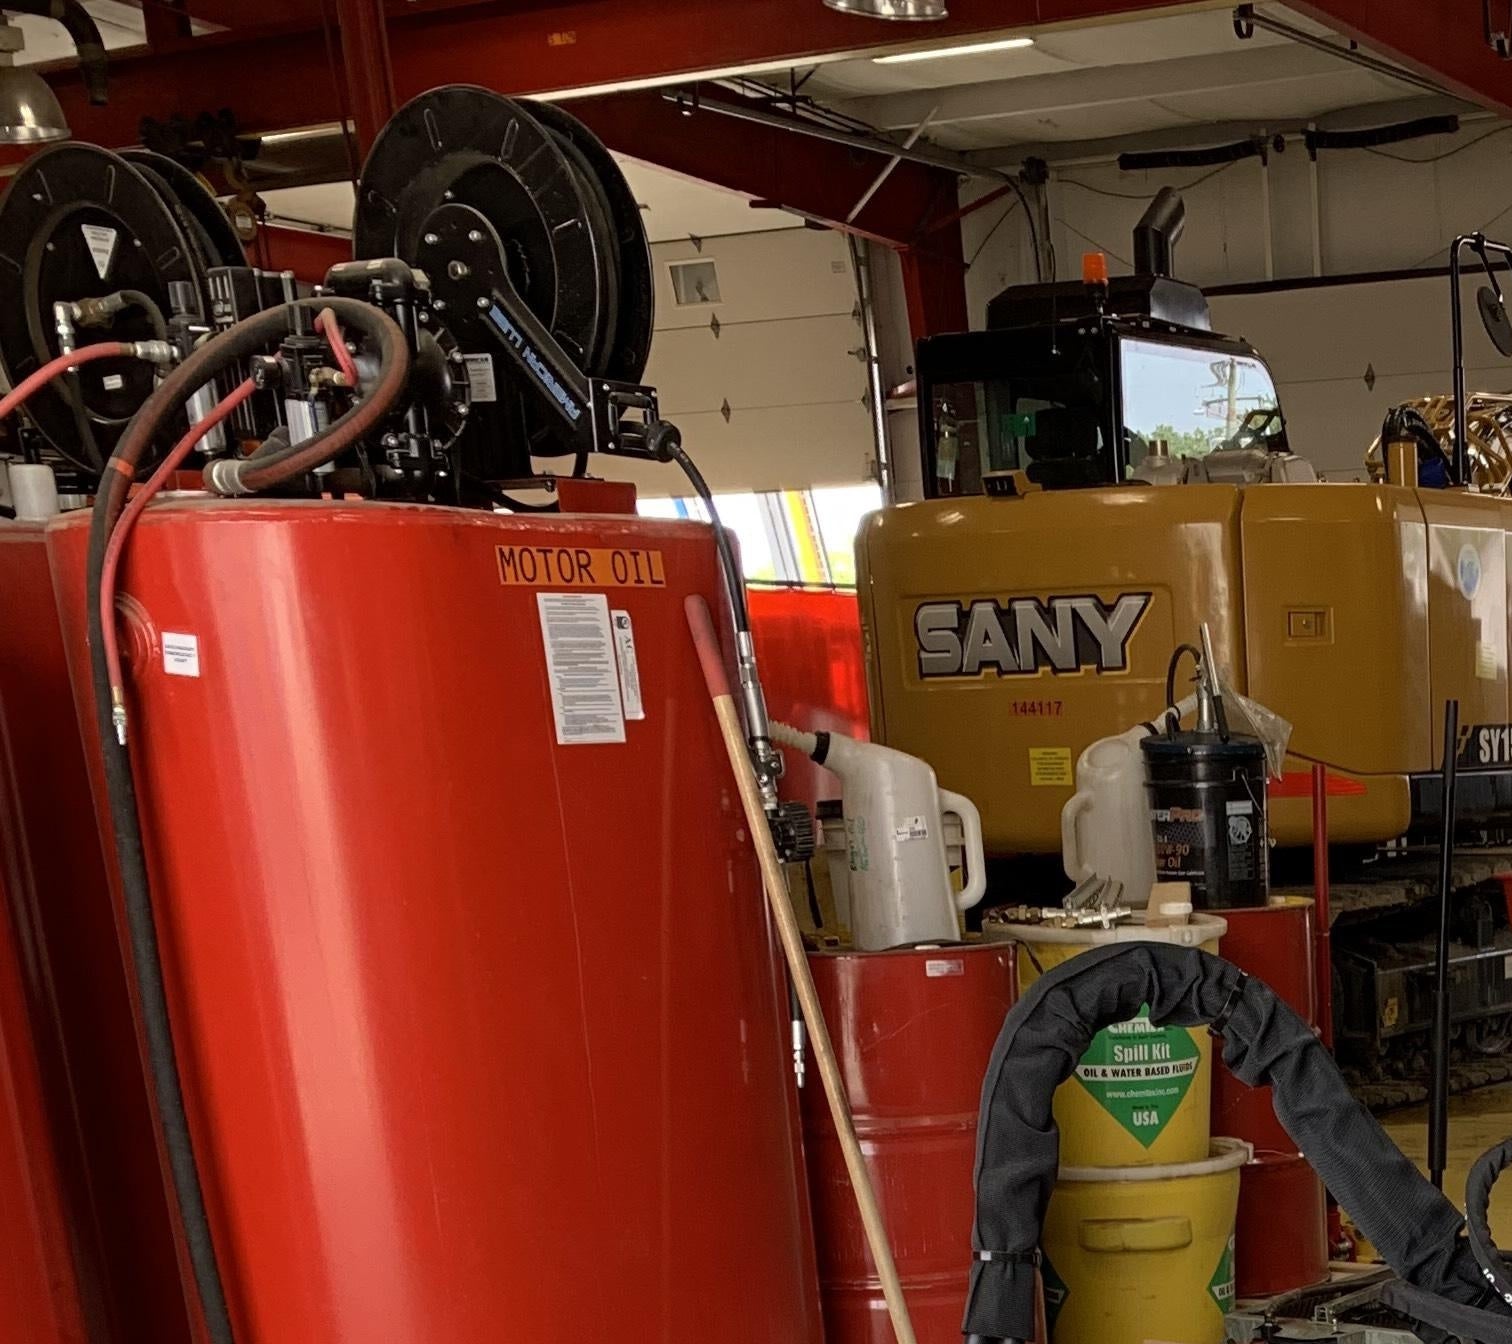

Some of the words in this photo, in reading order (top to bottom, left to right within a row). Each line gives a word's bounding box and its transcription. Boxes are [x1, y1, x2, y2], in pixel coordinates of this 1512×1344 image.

[498, 547, 596, 584] MOTOR
[611, 550, 664, 585] OIL
[914, 592, 1152, 679] SANY
[1011, 700, 1063, 716] 144117
[1113, 1044, 1149, 1064] Spill
[1152, 1042, 1171, 1061] Kit
[1083, 1069, 1098, 1078] OIL
[1101, 1069, 1109, 1078] &
[1111, 1067, 1142, 1078] WATER
[1145, 1066, 1170, 1077] BASED
[1132, 1110, 1160, 1127] USA
